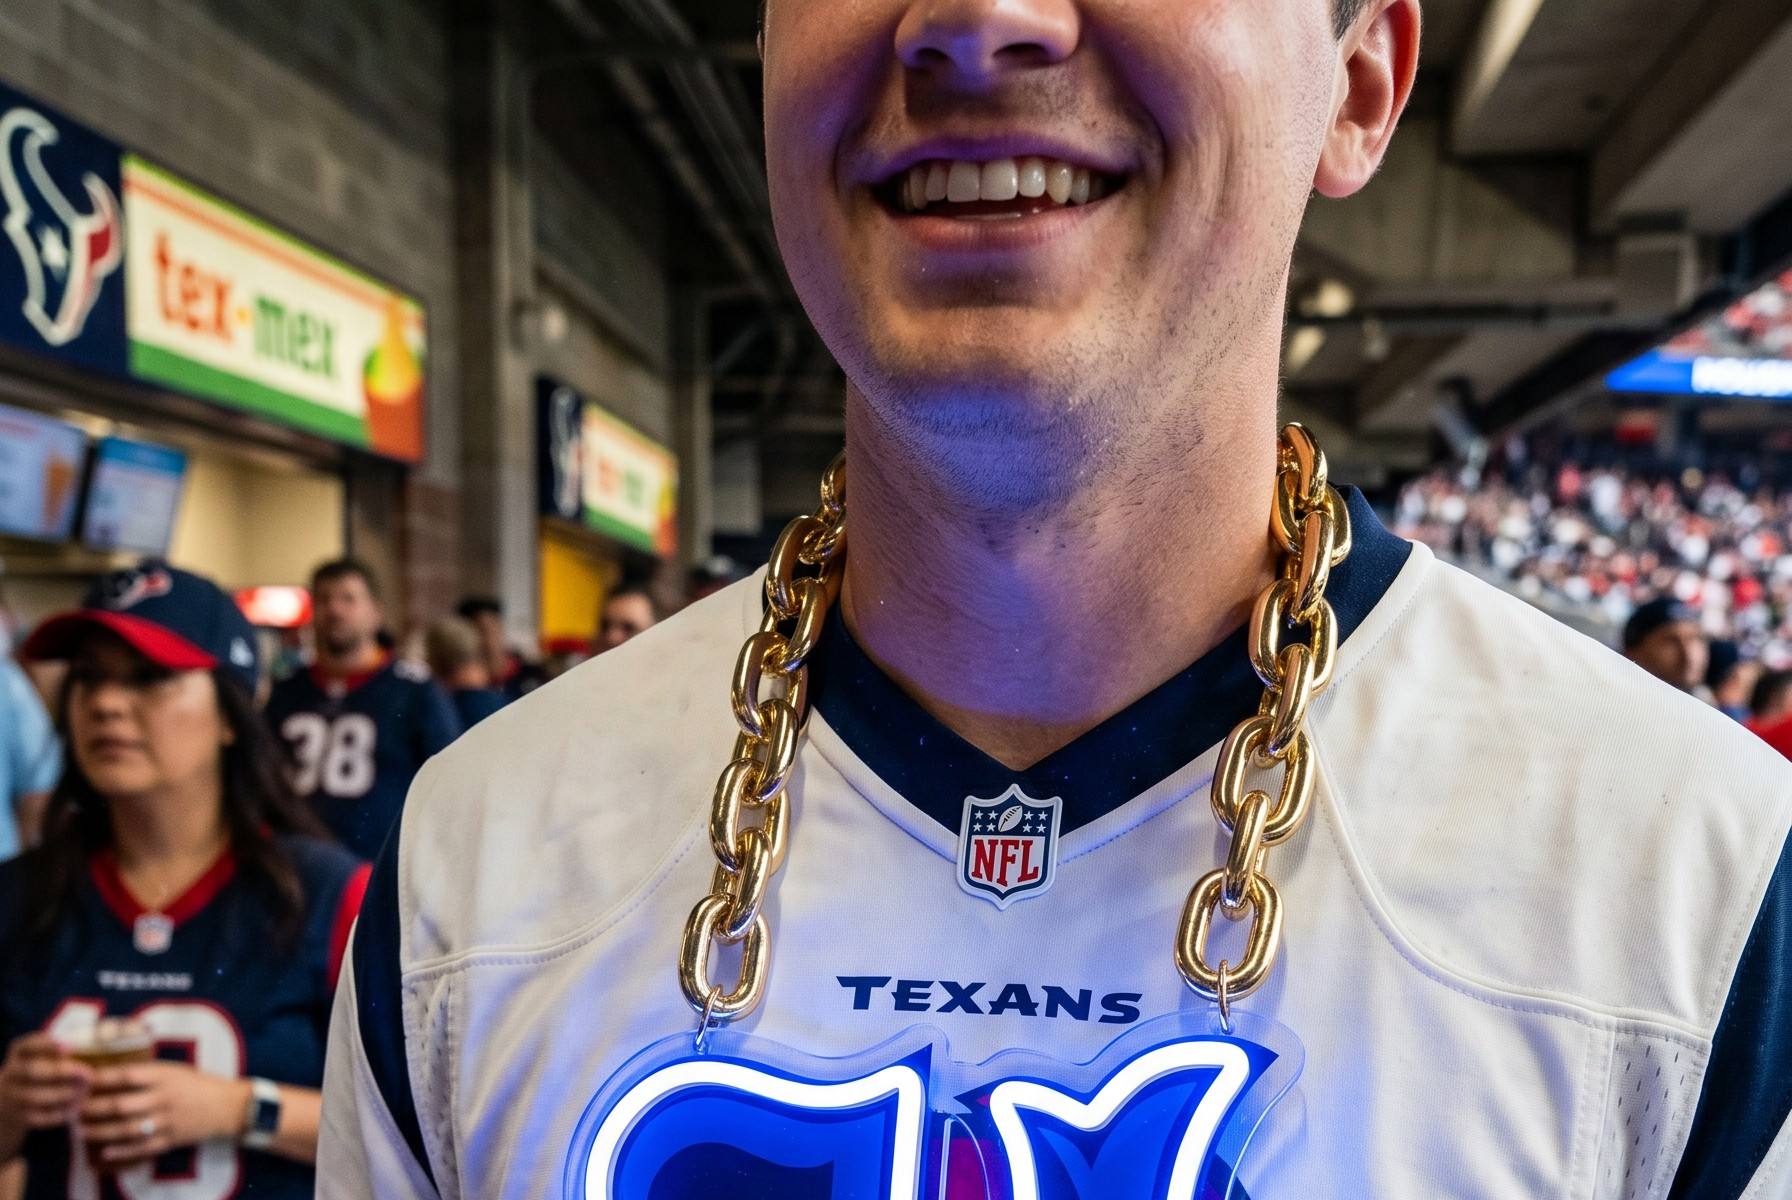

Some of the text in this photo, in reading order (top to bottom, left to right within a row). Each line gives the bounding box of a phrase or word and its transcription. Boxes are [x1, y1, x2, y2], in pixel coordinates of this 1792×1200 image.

[280, 711, 377, 798] 38
[971, 838, 1040, 887] NFL
[835, 975, 1144, 1025] TEXANS
